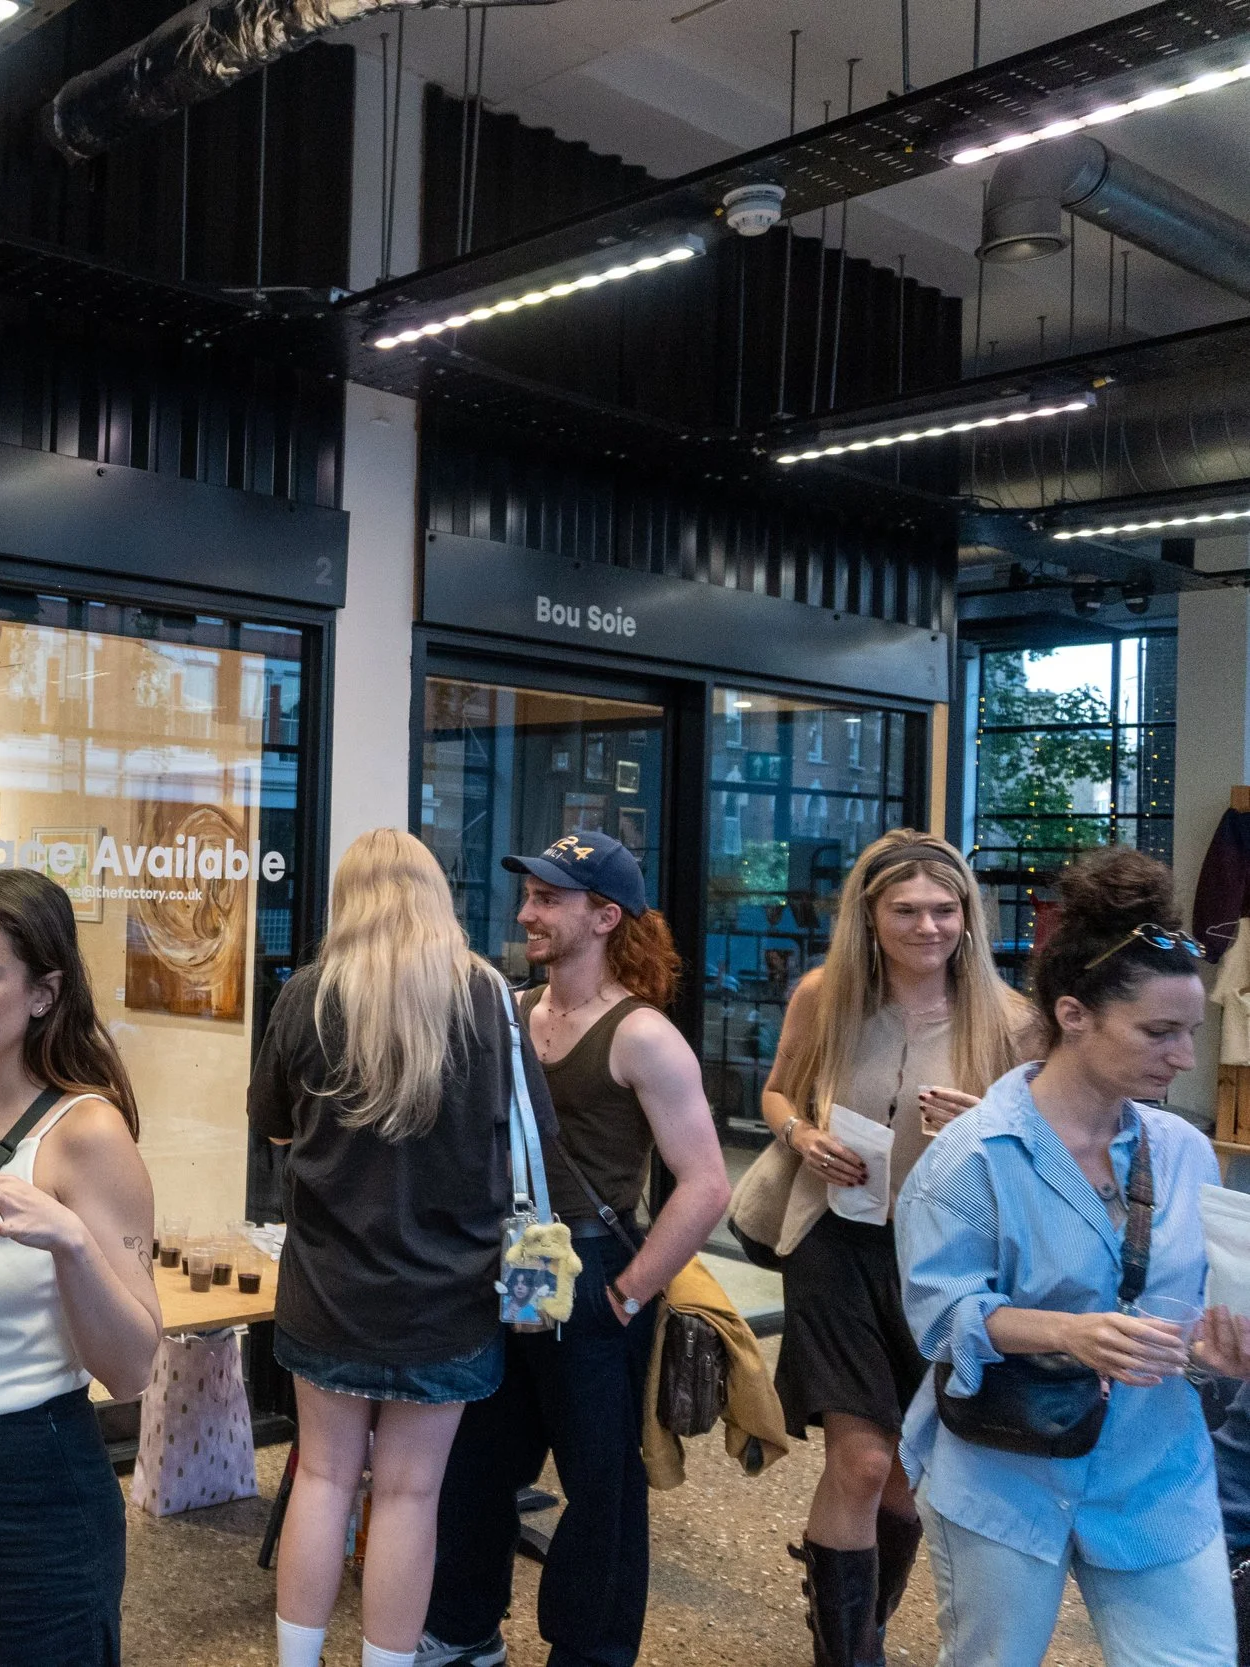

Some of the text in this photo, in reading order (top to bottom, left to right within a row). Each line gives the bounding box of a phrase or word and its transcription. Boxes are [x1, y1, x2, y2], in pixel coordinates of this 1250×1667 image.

[315, 556, 333, 585] 2
[536, 595, 637, 637] Bou Soie
[90, 833, 286, 882] Available
[66, 883, 203, 904] es@thefactory.co.uk
